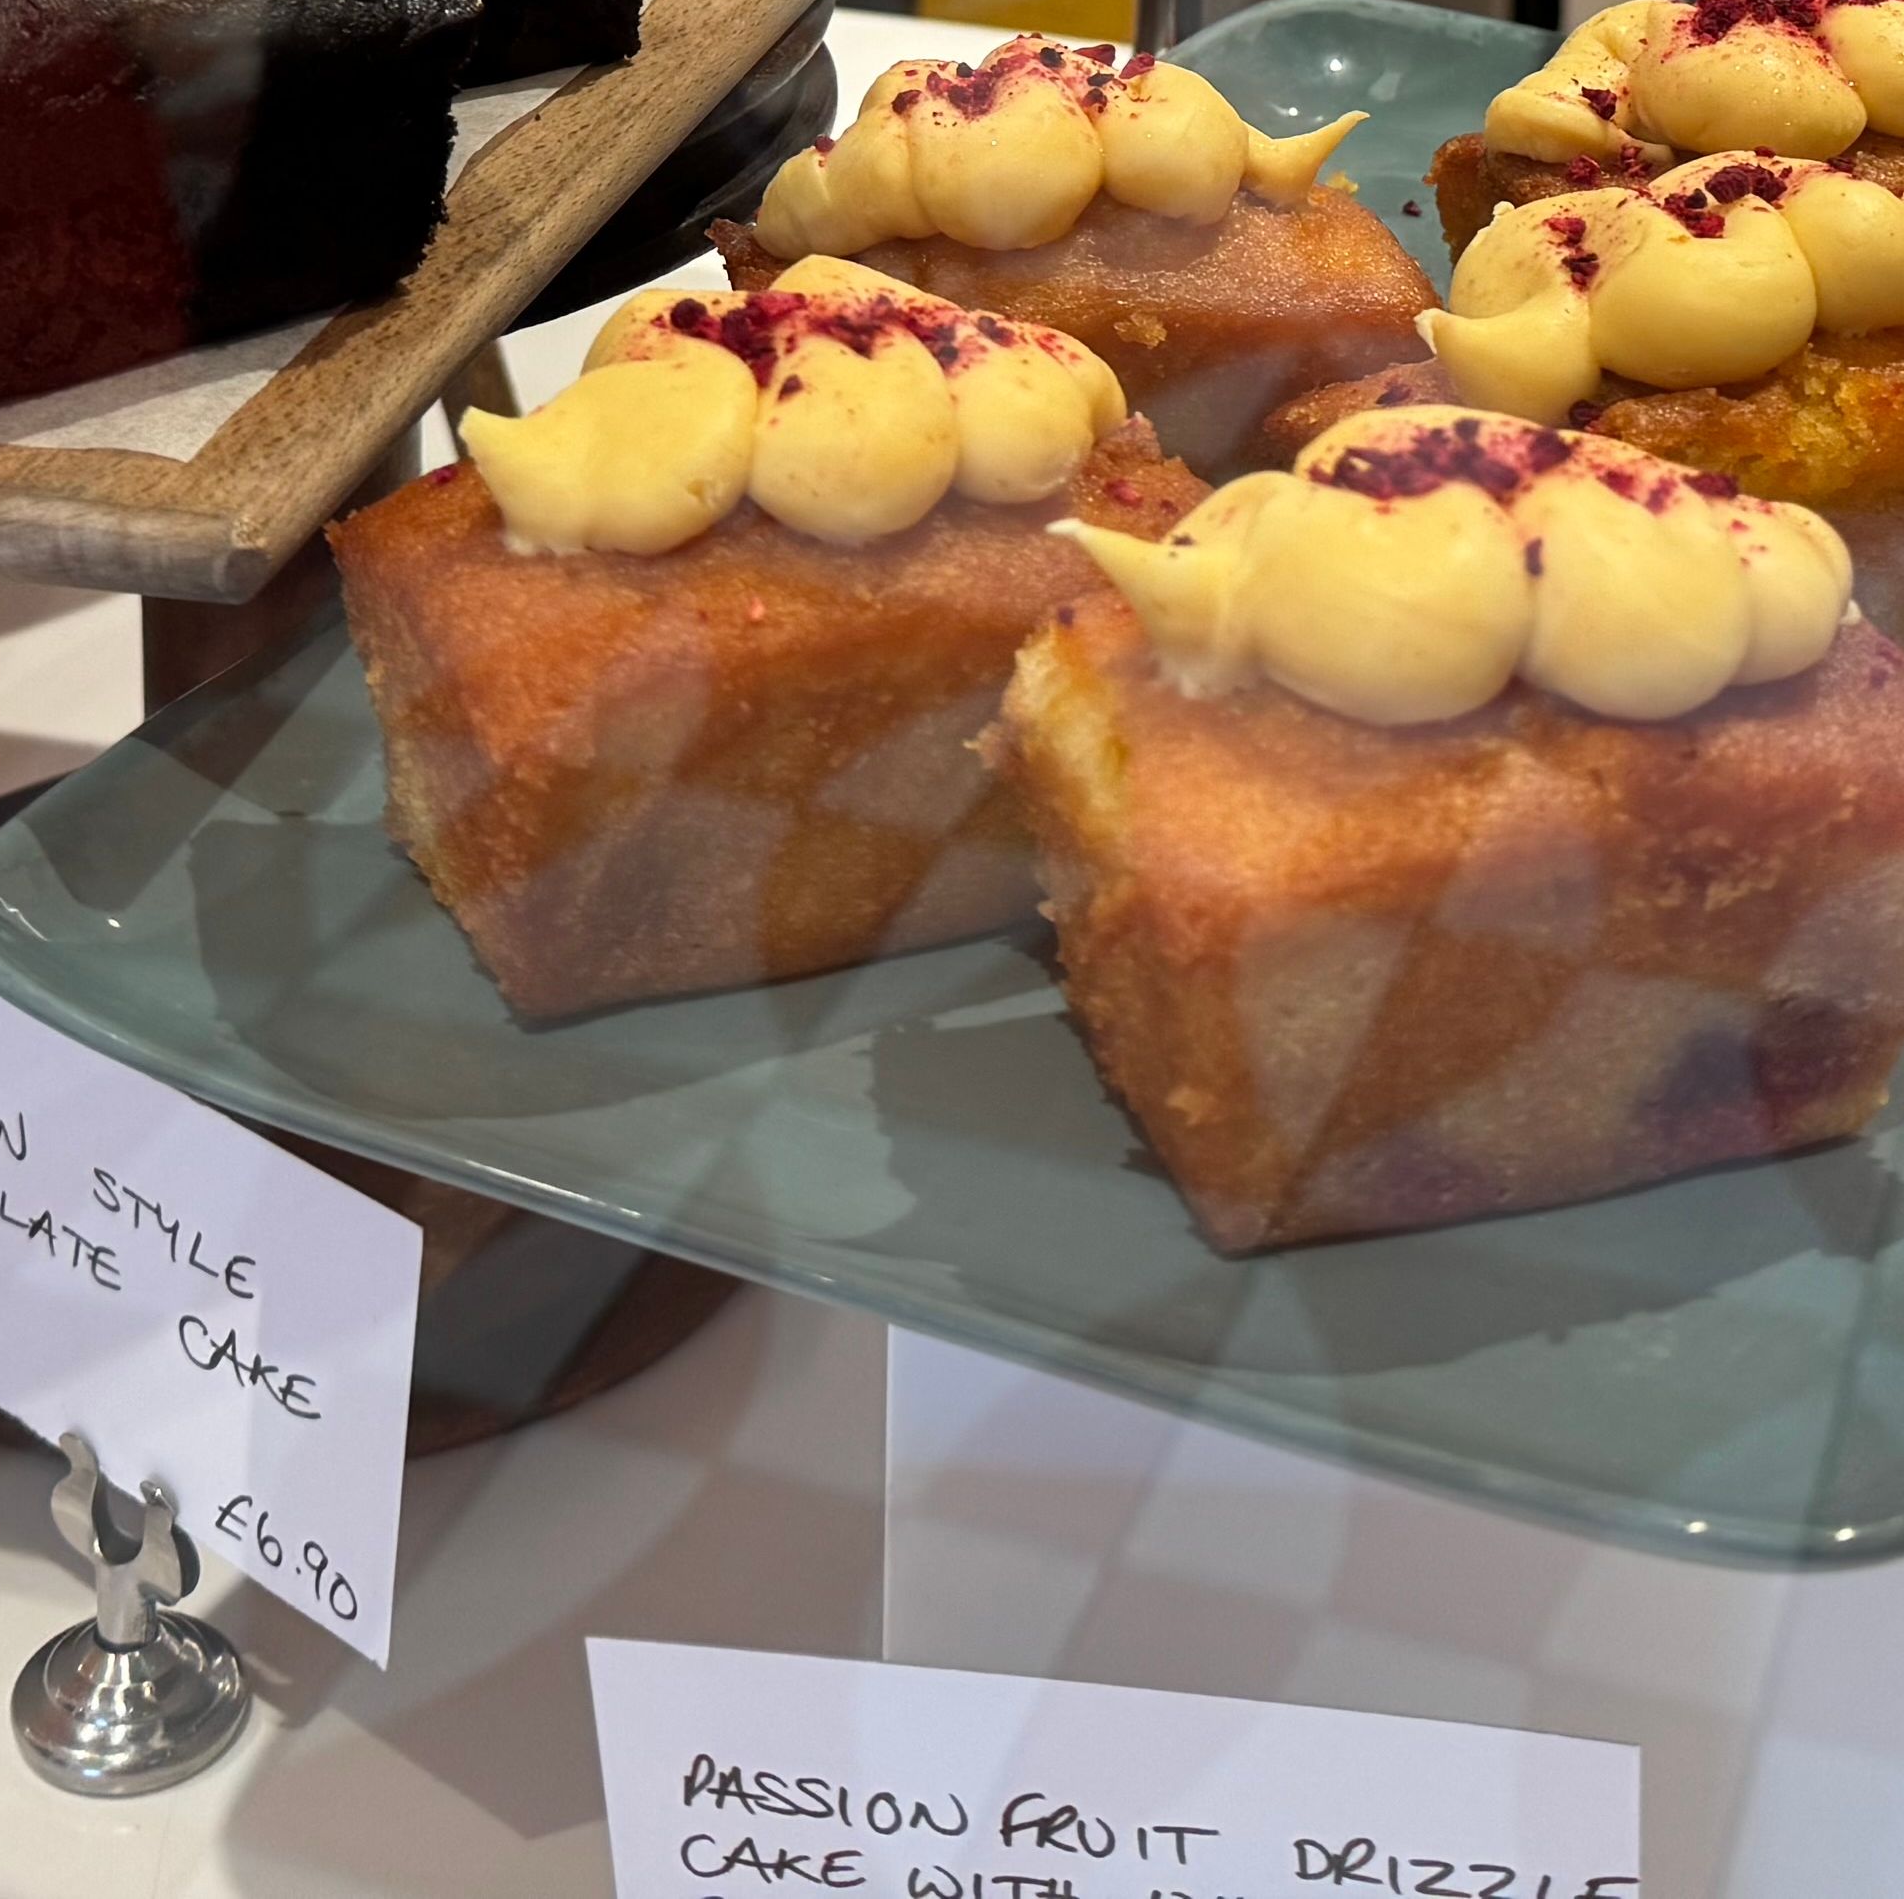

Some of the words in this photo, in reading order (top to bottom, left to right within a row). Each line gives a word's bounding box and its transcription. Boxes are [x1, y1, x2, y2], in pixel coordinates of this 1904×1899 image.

[91, 1167, 257, 1300] STYLE
[177, 1314, 321, 1420] CAKE
[214, 1494, 358, 1621] £6.90
[680, 1833, 867, 1888] CAKE
[683, 1753, 969, 1838] PASSION
[999, 1792, 1221, 1865] FRUIT
